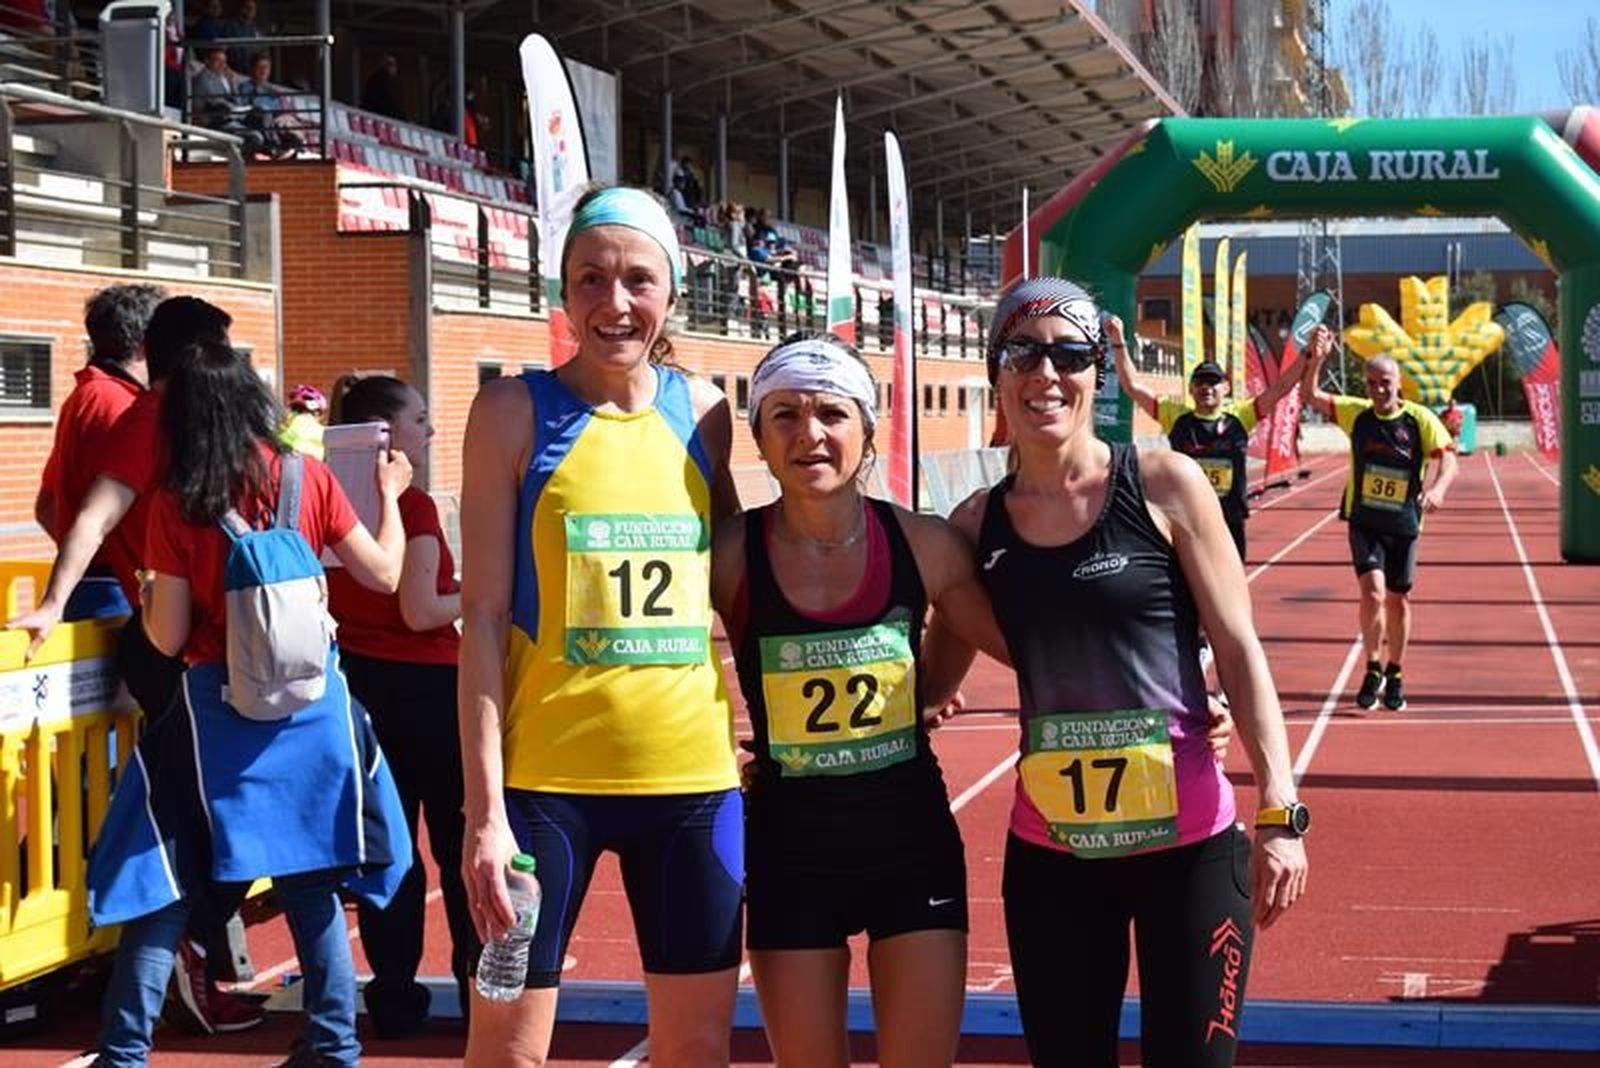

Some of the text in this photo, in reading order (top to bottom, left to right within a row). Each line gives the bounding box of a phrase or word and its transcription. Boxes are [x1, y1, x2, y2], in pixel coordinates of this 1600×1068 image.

[1266, 149, 1501, 183] CAJA RURAL
[1371, 478, 1397, 497] 36
[614, 535, 695, 548] CAJA RURAL
[608, 559, 673, 618] 12
[612, 638, 704, 654] CAJA RURAL
[807, 645, 895, 668] CAJA RURAL
[802, 673, 883, 733] 22
[1062, 731, 1150, 749] CAJA RURAL
[815, 737, 909, 768] CAJA RURAL
[1059, 757, 1128, 814] 17
[1068, 832, 1109, 849] CAJA
